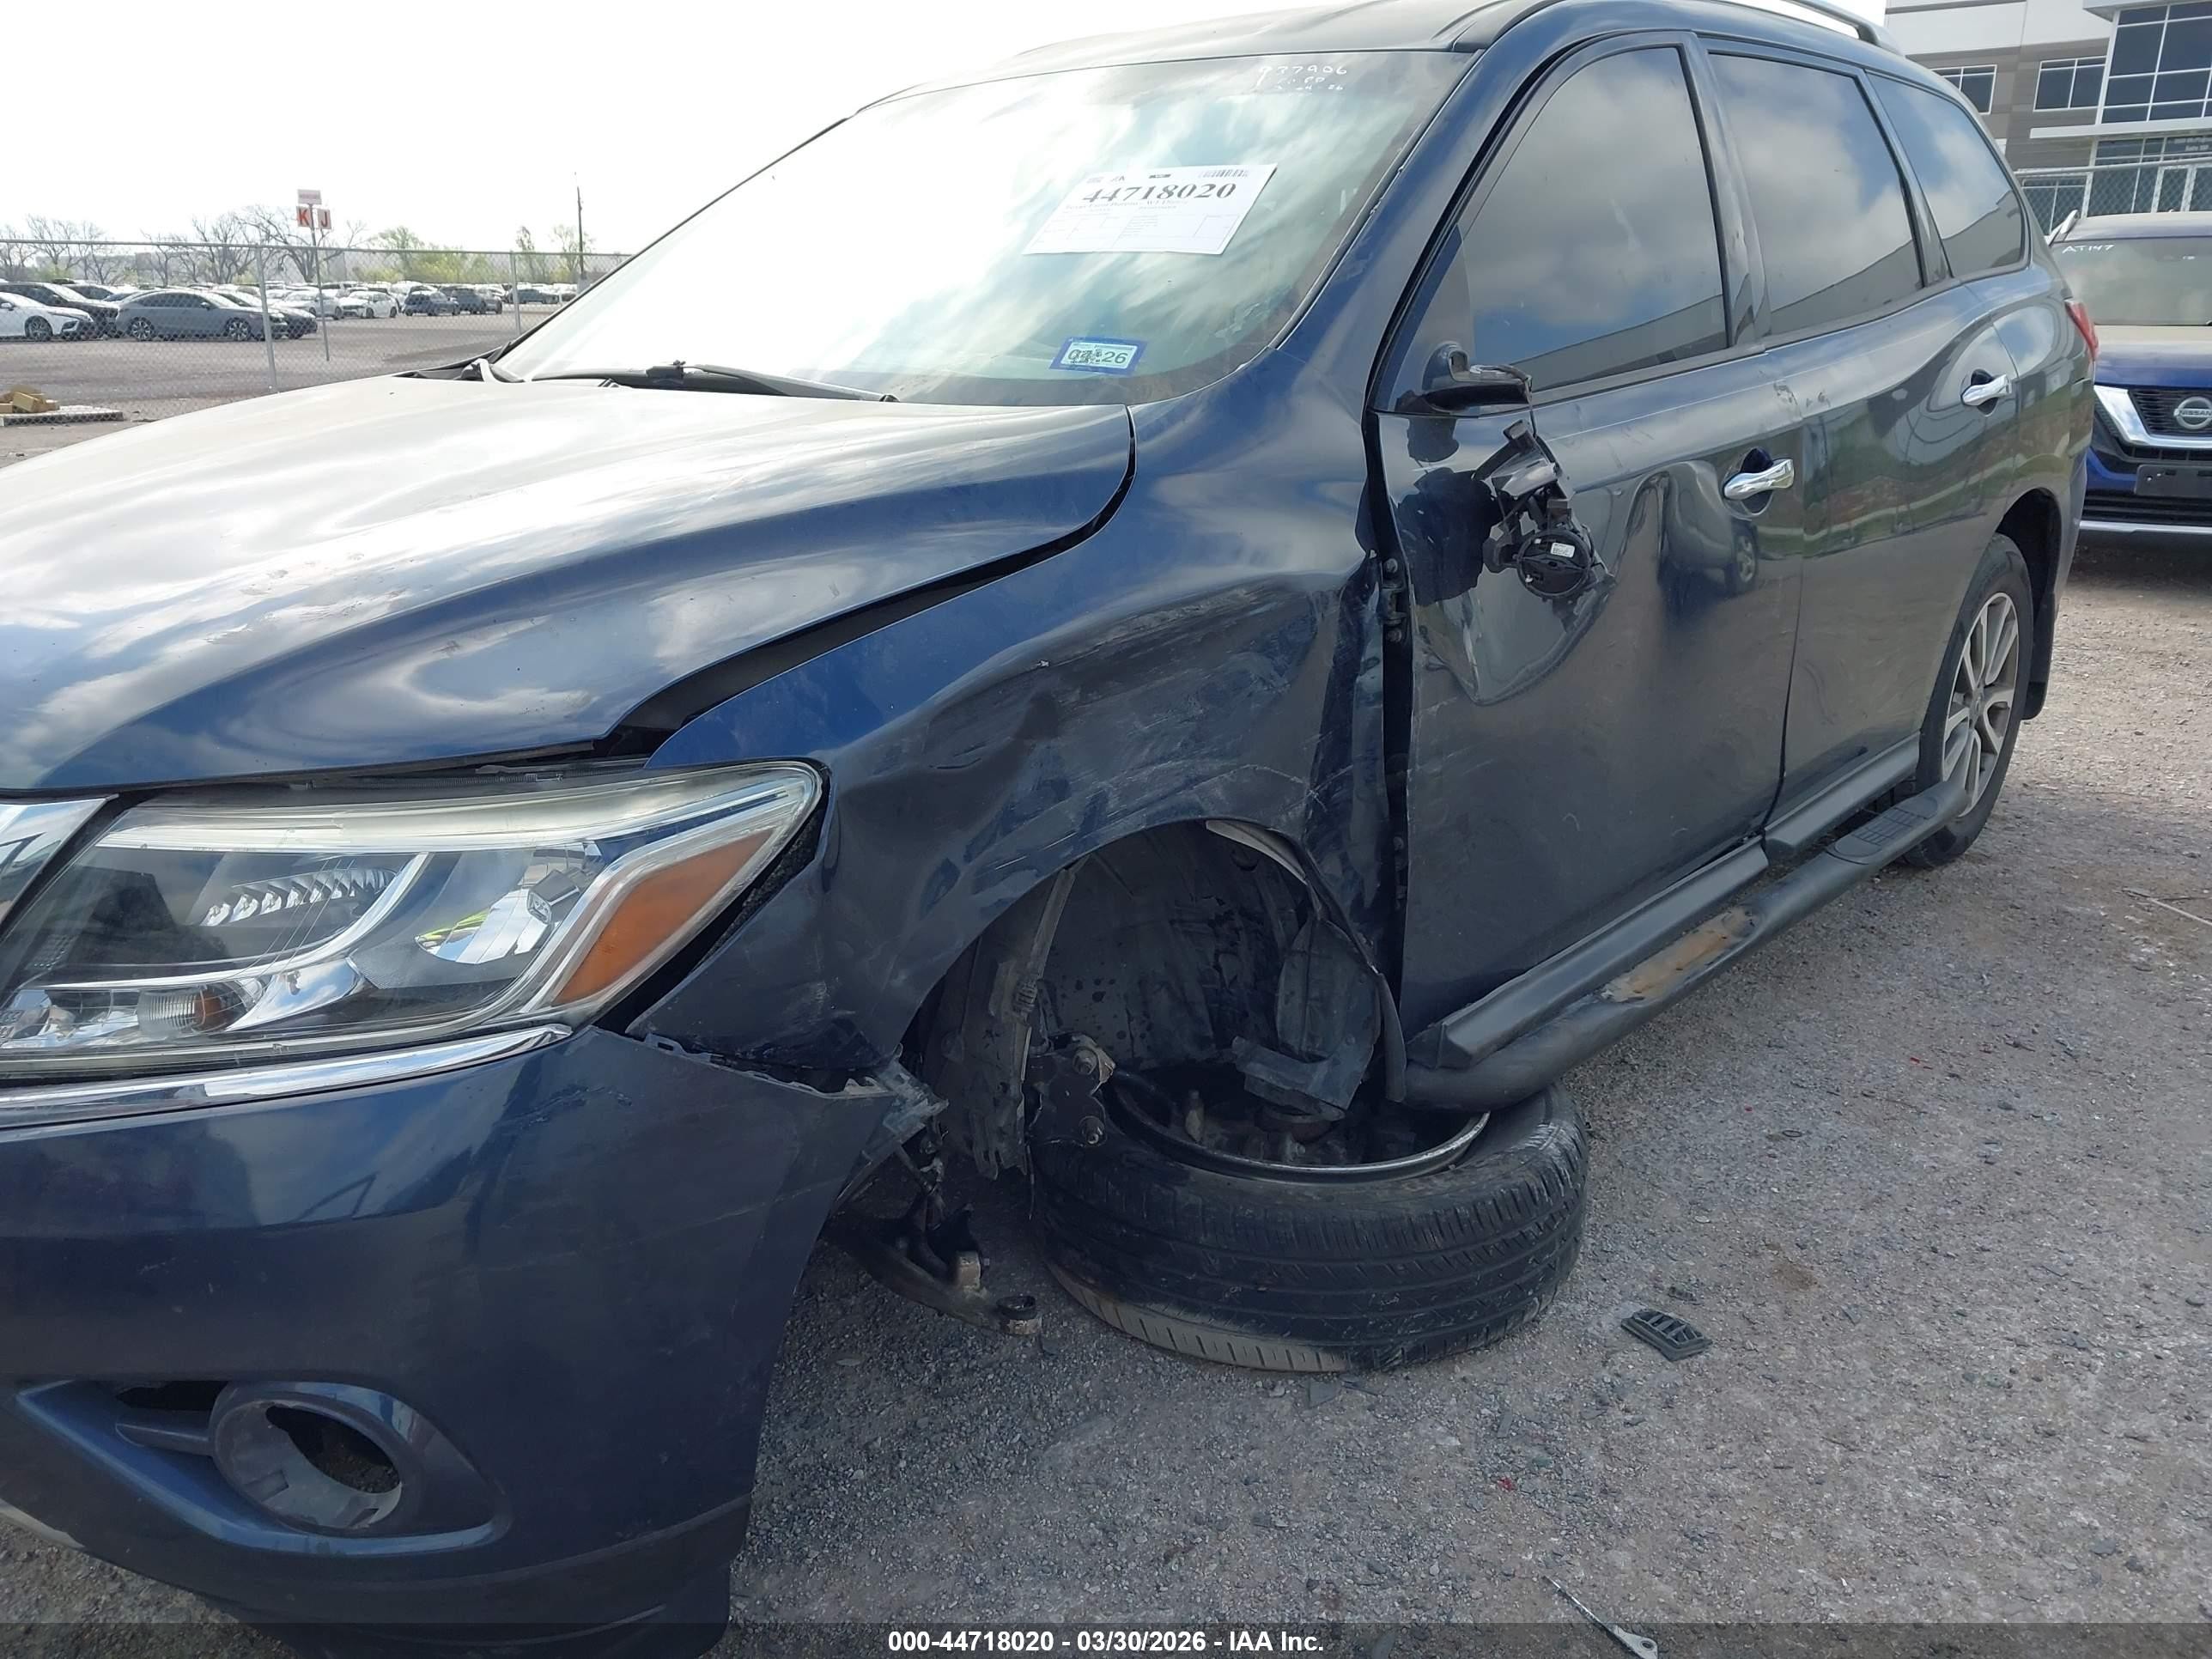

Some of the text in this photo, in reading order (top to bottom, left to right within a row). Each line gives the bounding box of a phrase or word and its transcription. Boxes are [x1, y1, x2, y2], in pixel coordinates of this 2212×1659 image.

[1082, 183, 1237, 203] 44718020
[298, 208, 310, 226] K
[320, 210, 328, 228] J
[1101, 351, 1129, 364] 26
